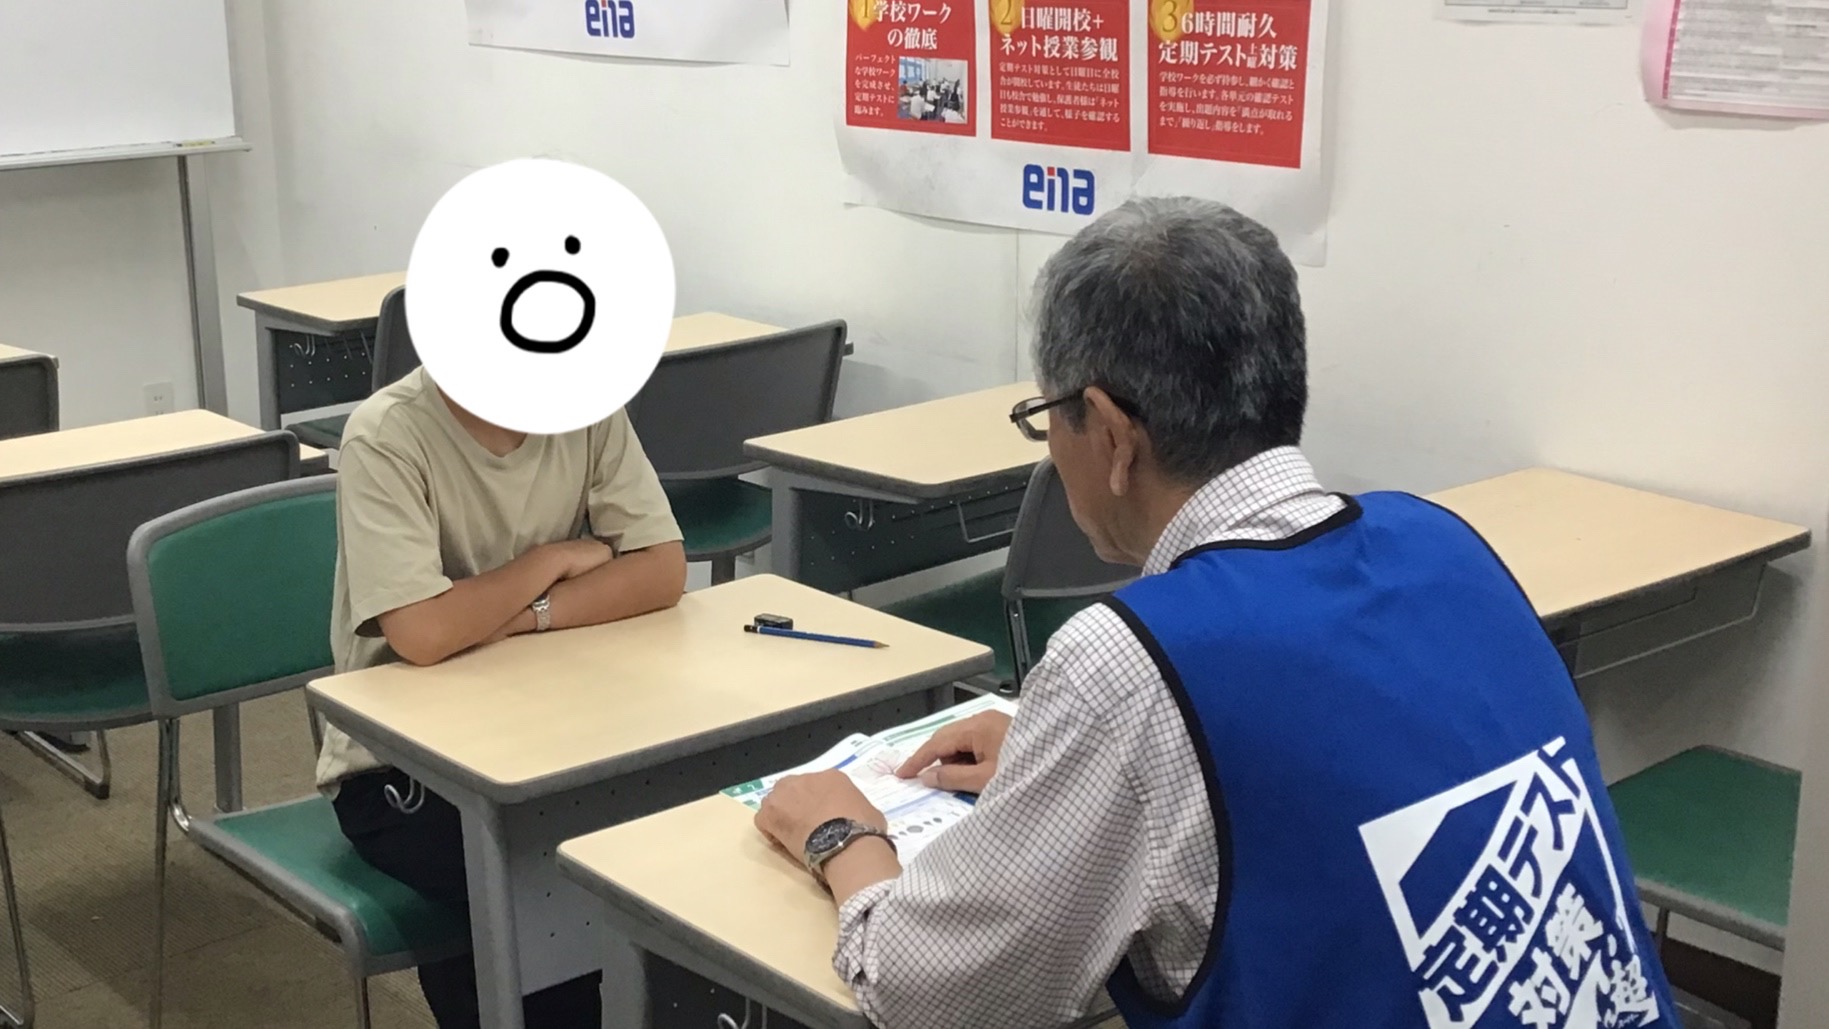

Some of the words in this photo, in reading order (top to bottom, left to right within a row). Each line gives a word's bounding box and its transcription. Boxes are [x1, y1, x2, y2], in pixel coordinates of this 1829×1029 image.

[585, 0, 635, 38] ena
[873, 0, 952, 24] 学校ワーク
[1181, 11, 1278, 39] 6時間耐久
[887, 27, 938, 50] の徹底
[1000, 33, 1119, 62] ネット授業参観
[1023, 164, 1095, 216] ena
[1414, 747, 1582, 1023] 定期テスト
[1508, 882, 1604, 1029] 対策
